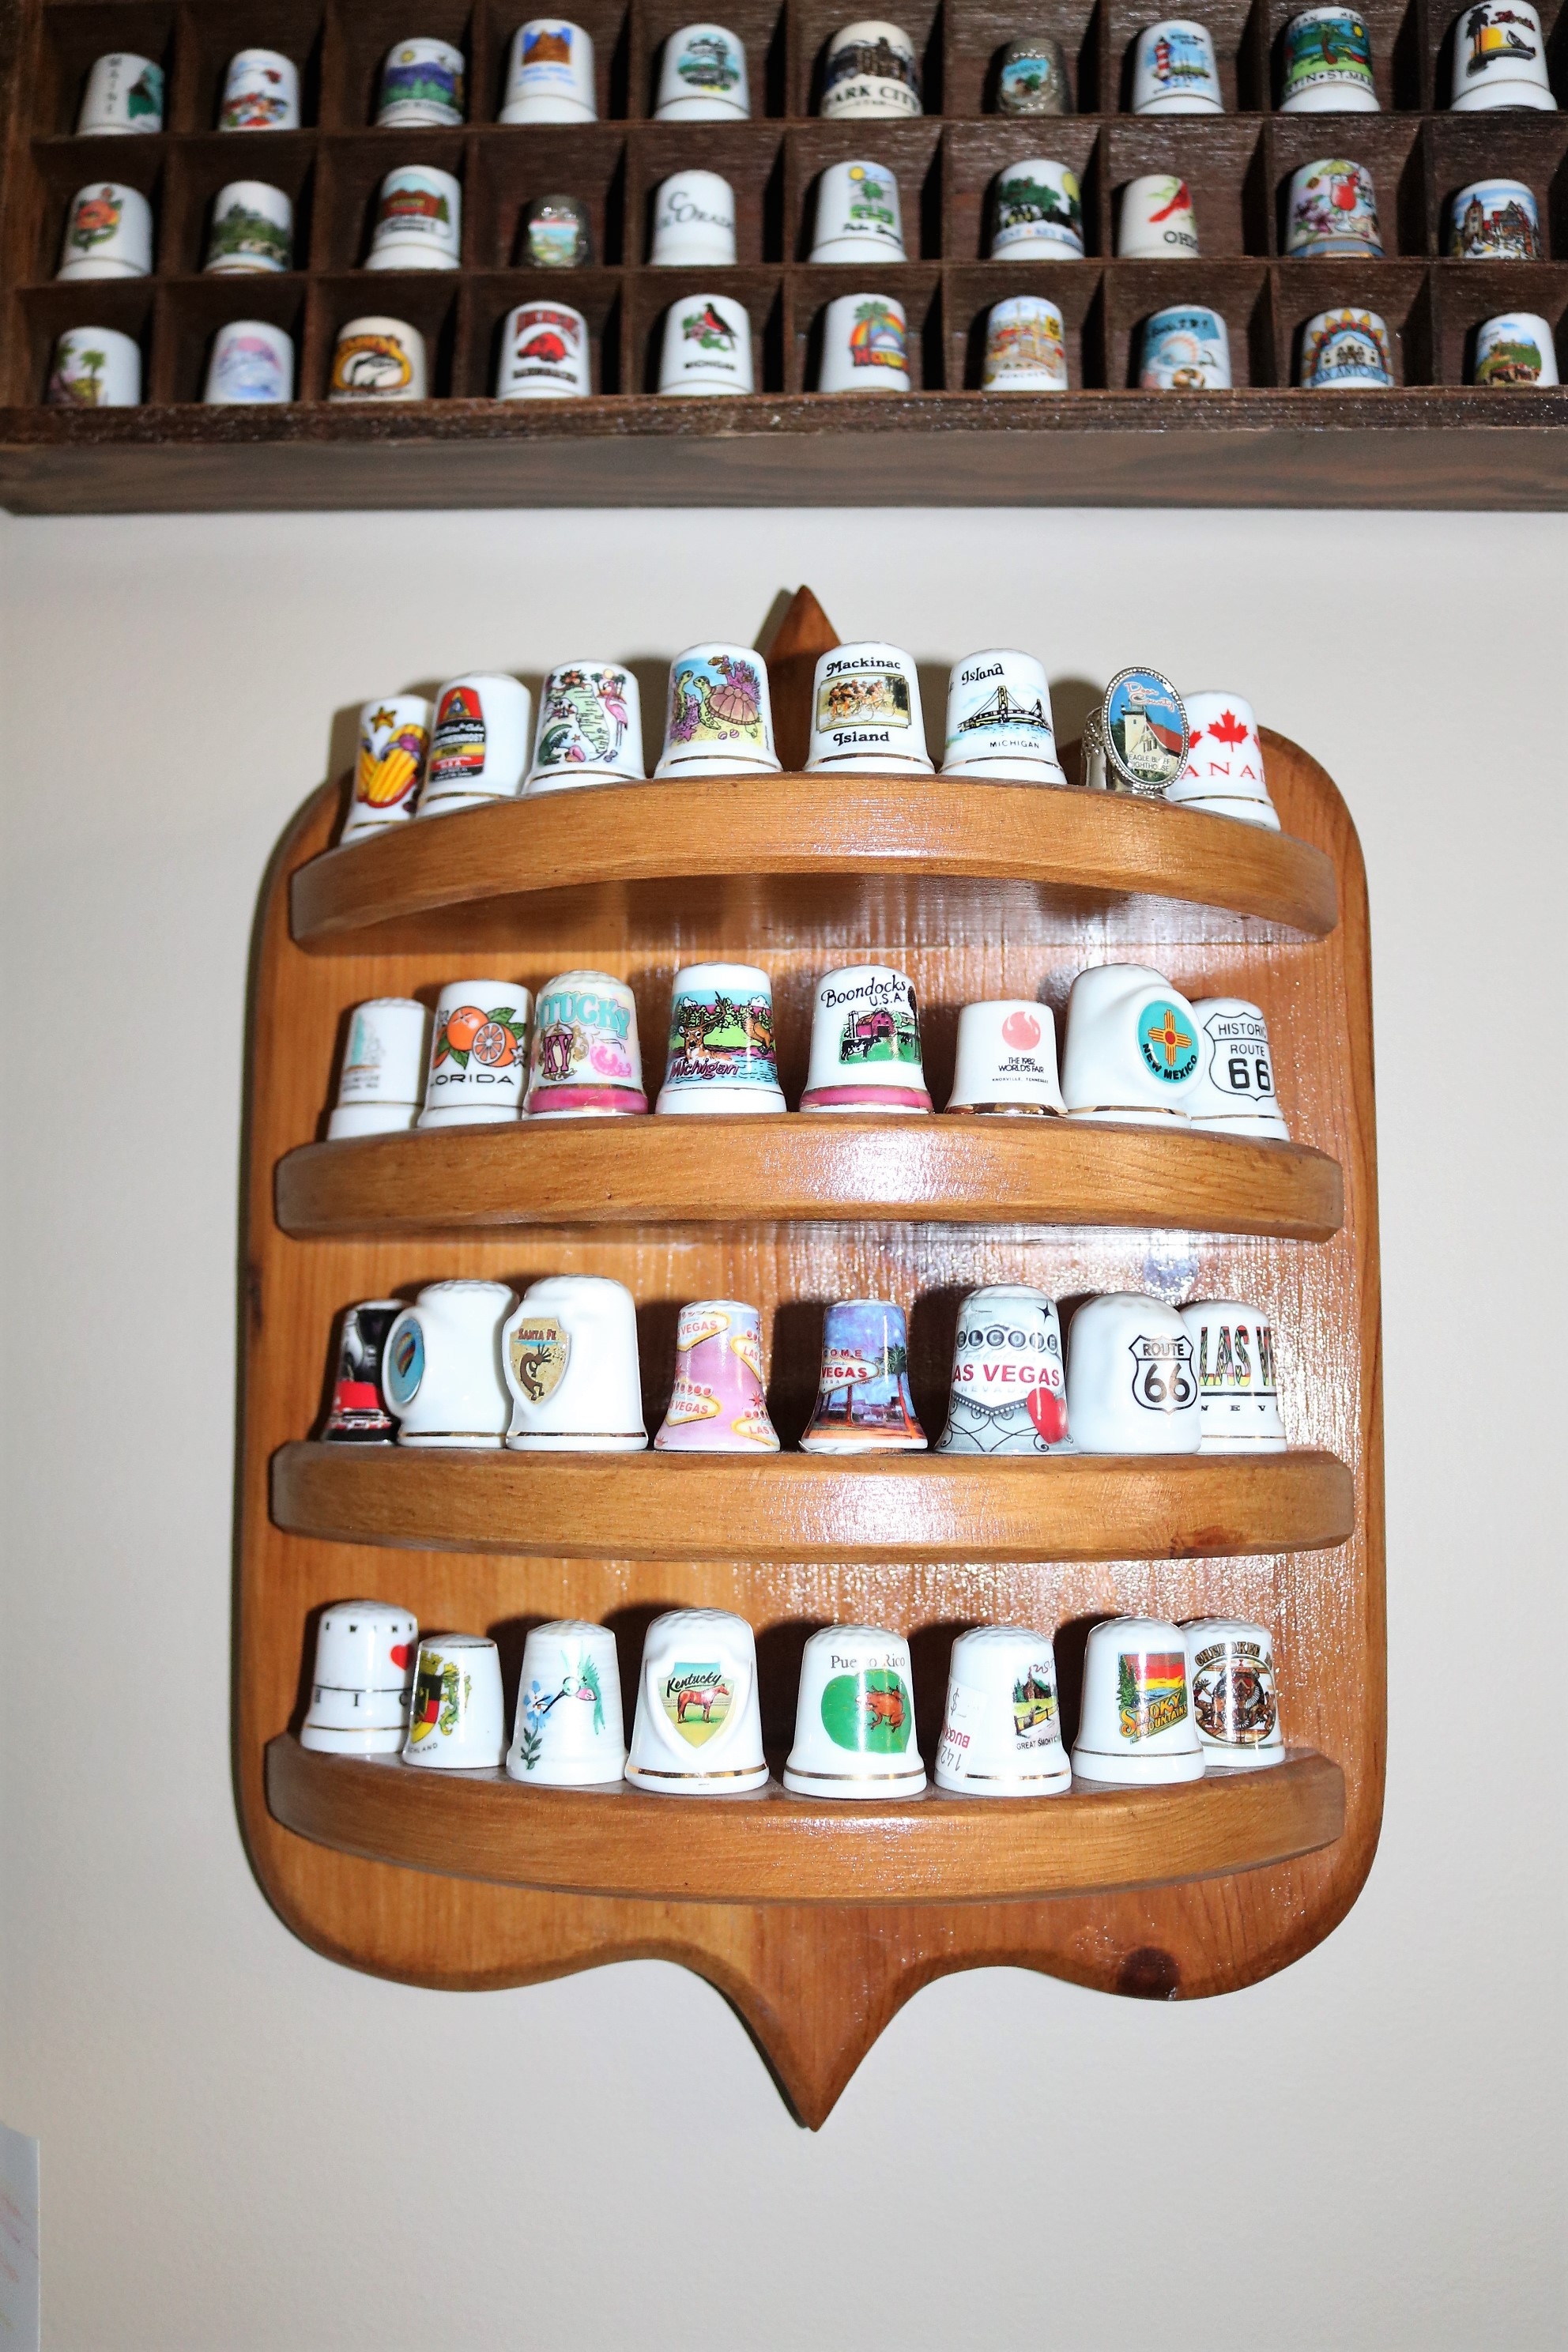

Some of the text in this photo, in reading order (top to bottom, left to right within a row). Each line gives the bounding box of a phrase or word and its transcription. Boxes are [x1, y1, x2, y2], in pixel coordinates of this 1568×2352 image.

[826, 657, 901, 677] Mackinac
[962, 662, 1004, 686] Island
[1124, 681, 1159, 696] Door
[1129, 692, 1174, 713] County
[833, 731, 890, 746] Island
[989, 740, 1039, 749] MICHIGAN
[1128, 761, 1170, 772] IGHTHOSE
[1181, 762, 1266, 783] ANA
[821, 974, 906, 1008] Boondocks
[869, 993, 906, 1008] U.S.A.
[547, 1034, 575, 1076] KY
[1230, 1043, 1265, 1057] ROUTE
[670, 1060, 741, 1081] Michigan
[998, 1065, 1044, 1074] WORLD'S FAIR
[1163, 1054, 1198, 1081] MEXICO
[1228, 1057, 1271, 1091] 66
[430, 1073, 514, 1087] ORIDA
[518, 1328, 545, 1340] SANTA
[680, 1320, 718, 1336] VEGAS
[1143, 1342, 1185, 1356] ROUTE
[952, 1363, 1061, 1387] AS VEGAS
[1144, 1363, 1191, 1403] 66
[674, 1403, 708, 1415] VEGAS
[748, 1425, 770, 1436] LAS
[831, 1653, 906, 1669] Pueo Rico
[666, 1672, 722, 1698] Kentucky
[1016, 1740, 1036, 1751] GREAT
